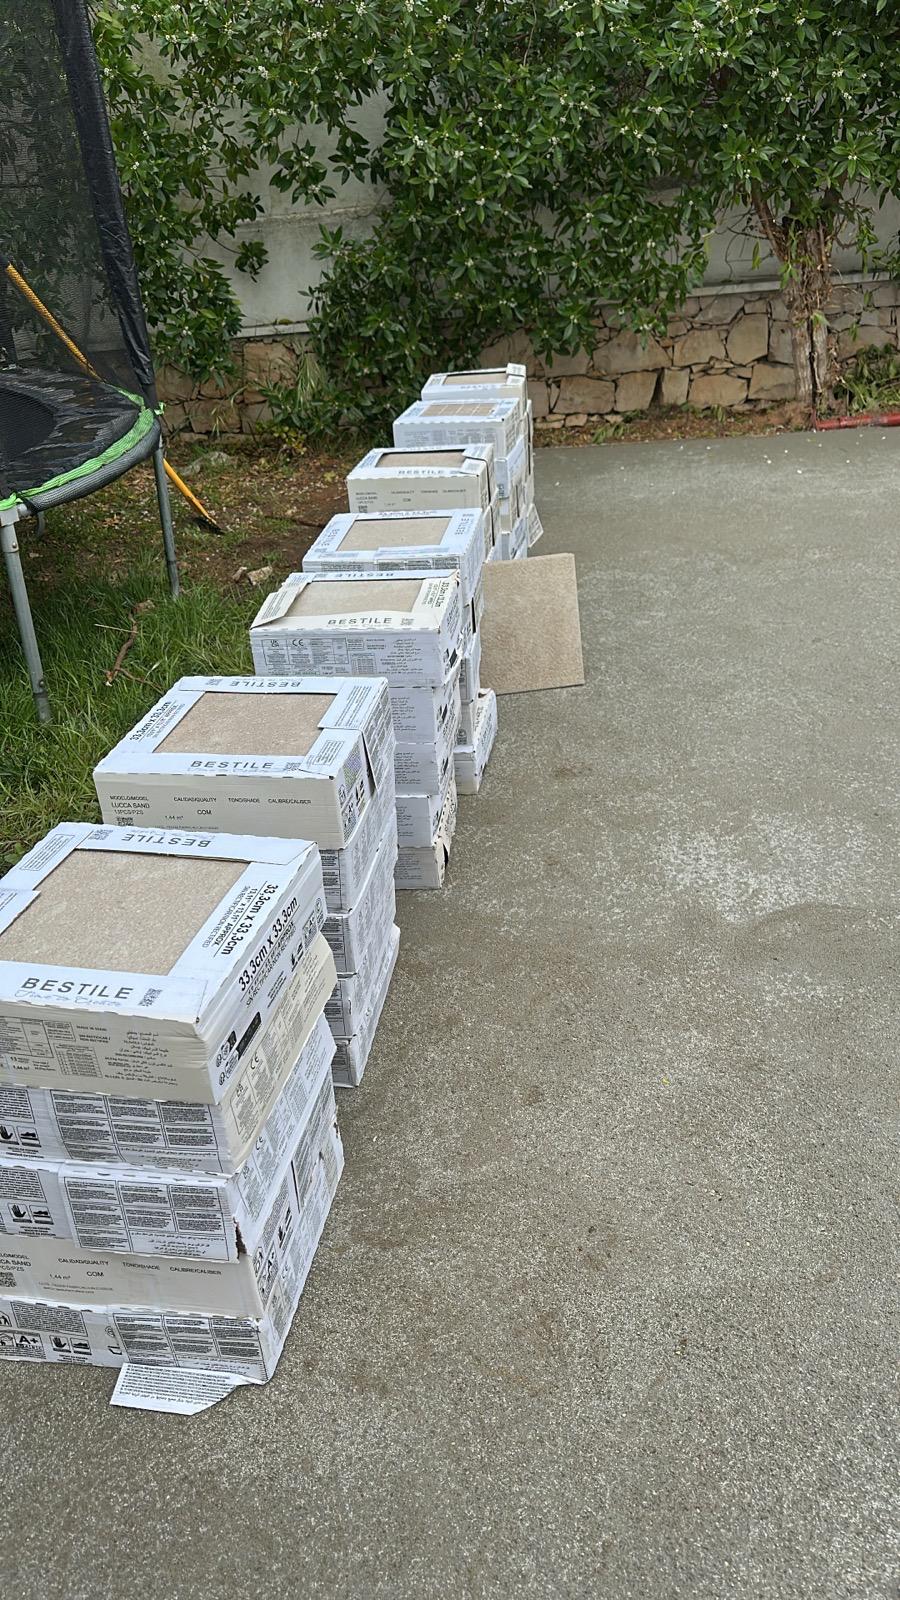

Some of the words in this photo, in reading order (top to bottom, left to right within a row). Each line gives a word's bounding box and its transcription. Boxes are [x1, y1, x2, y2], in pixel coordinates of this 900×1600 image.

[328, 617, 392, 625] BESTILE
[230, 680, 302, 688] BESTILE
[190, 760, 275, 769] BESTILE
[121, 833, 211, 848] BESTILE
[250, 884, 279, 914] 33,3cm
[221, 922, 252, 955] 33,3cm
[239, 945, 268, 991] 33,3cm
[273, 897, 298, 938] 33,3cm
[21, 977, 133, 1000] BESTILE
